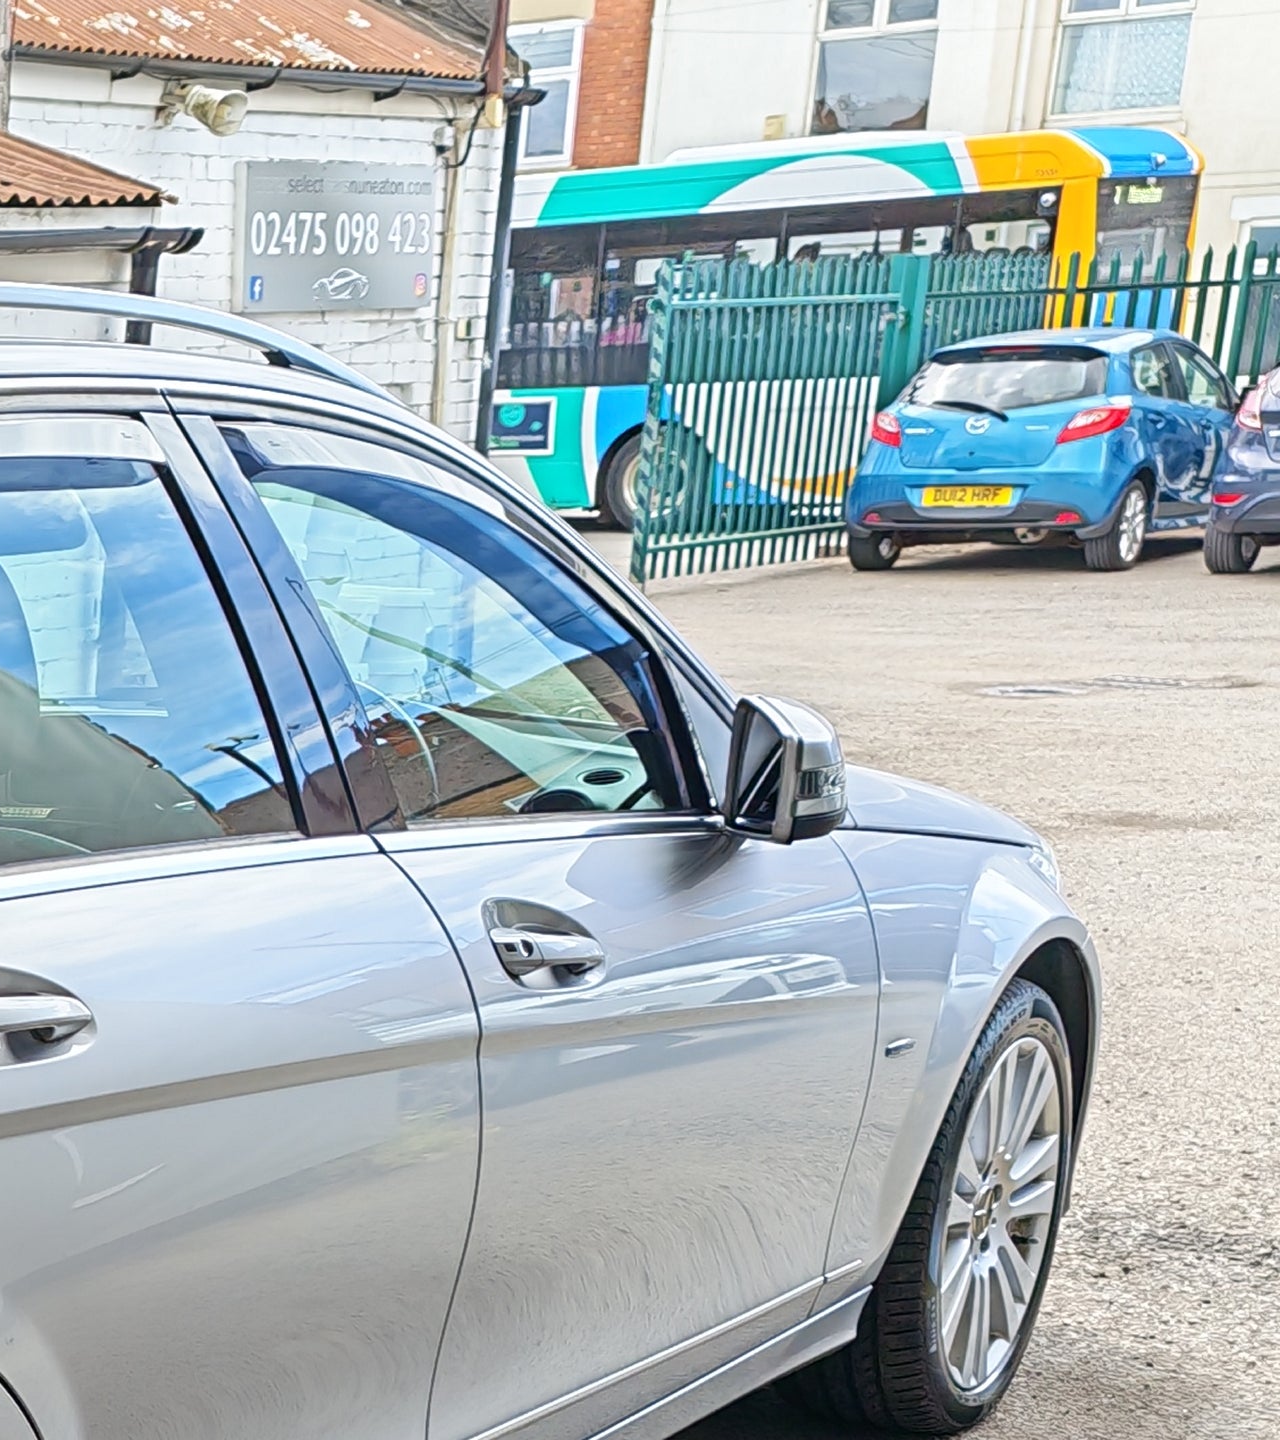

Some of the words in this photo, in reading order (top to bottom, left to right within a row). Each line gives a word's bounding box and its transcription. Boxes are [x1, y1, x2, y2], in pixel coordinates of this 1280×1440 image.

[251, 211, 327, 256] 02475
[335, 212, 379, 256] 098
[387, 212, 431, 255] 423
[971, 487, 1002, 502] HRF
